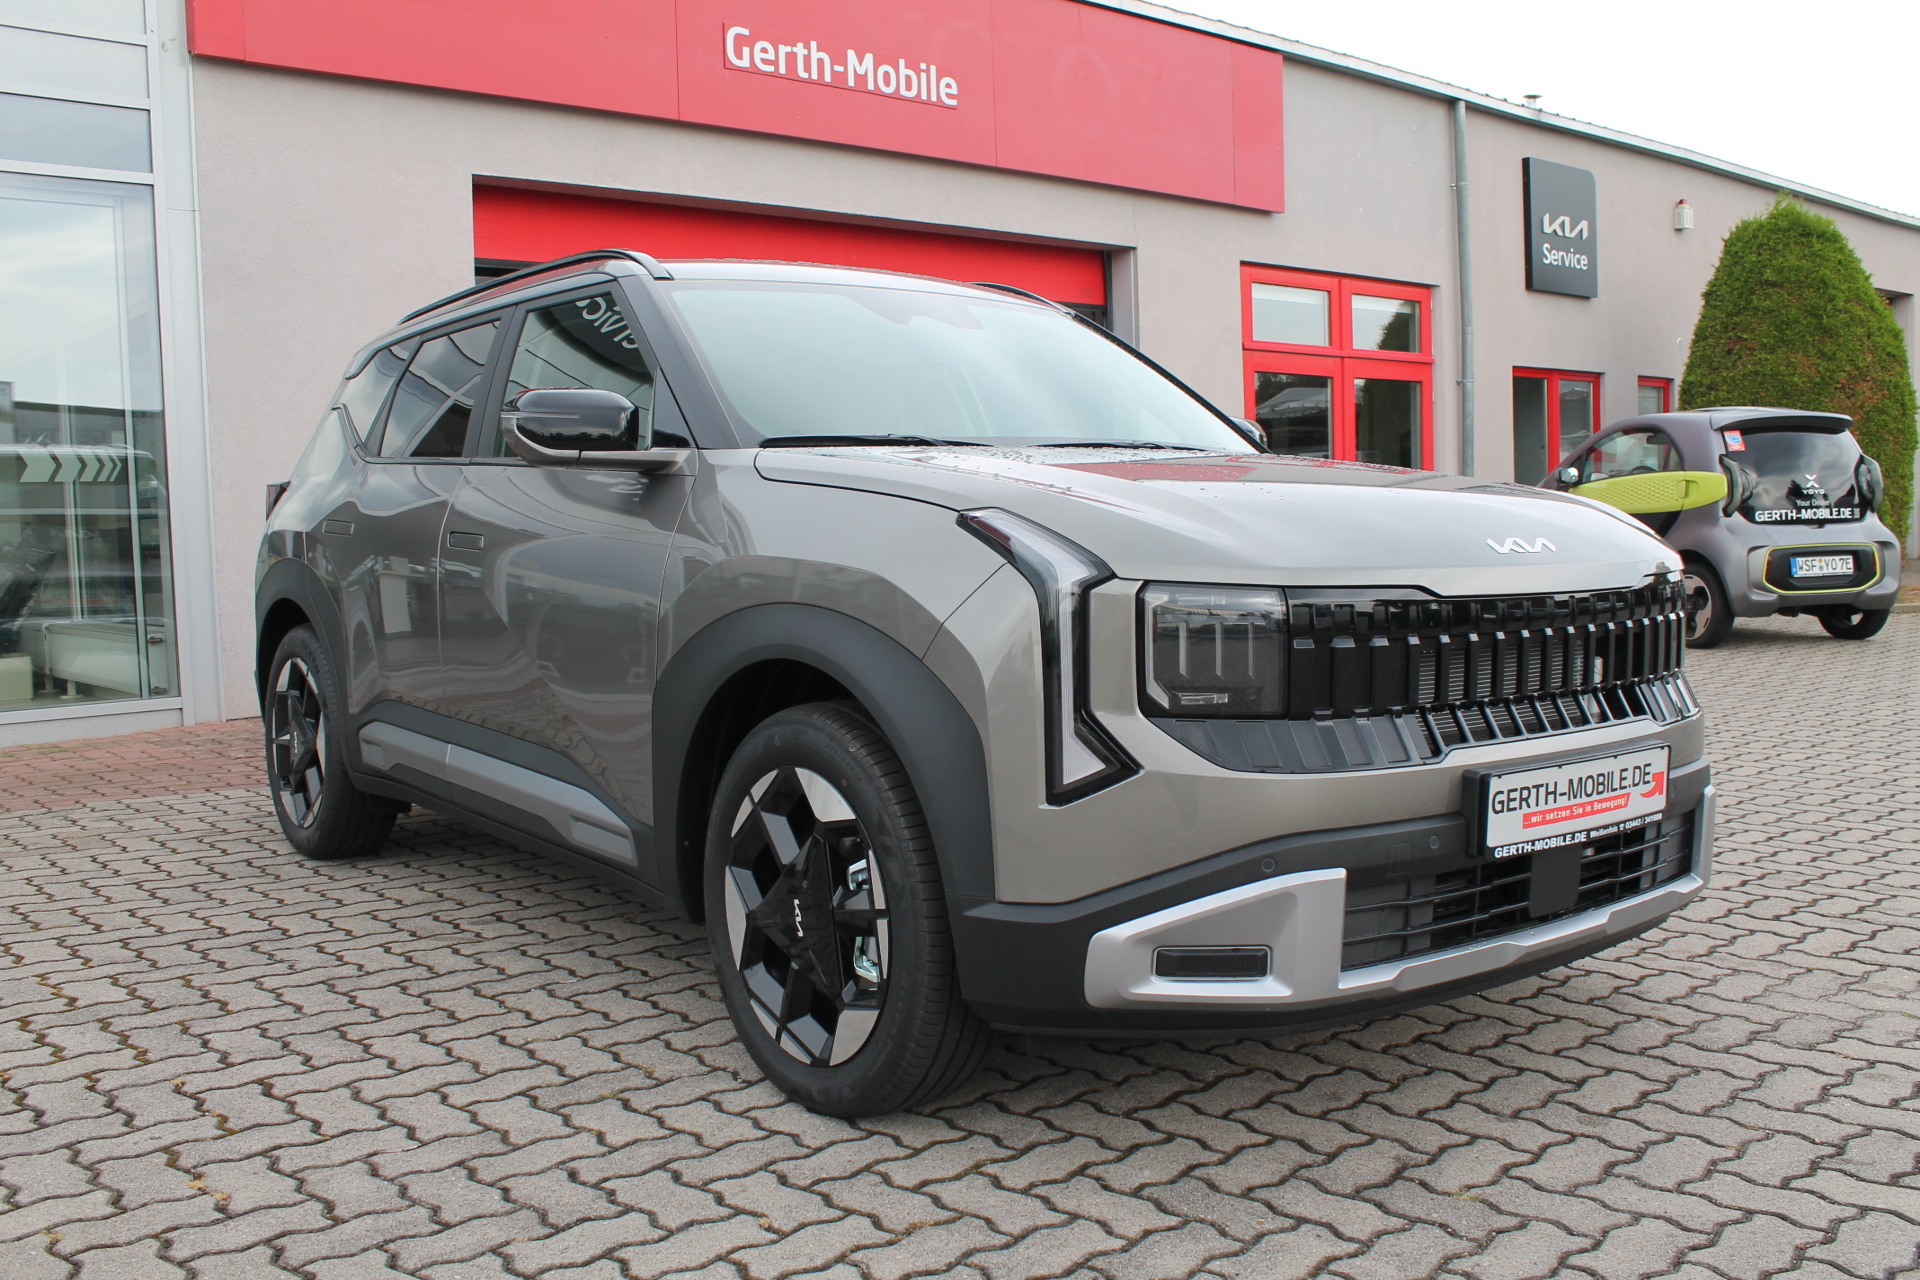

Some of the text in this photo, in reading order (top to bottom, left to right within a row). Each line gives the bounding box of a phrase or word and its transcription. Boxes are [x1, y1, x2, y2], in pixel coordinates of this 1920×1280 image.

[726, 26, 958, 106] Gerth-Mobile
[1542, 212, 1589, 240] KIA
[1542, 243, 1588, 270] Service
[1755, 508, 1852, 521] GERTH-MOBILE.DE
[1486, 537, 1557, 554] KIA
[1797, 558, 1817, 572] WSF
[1491, 763, 1652, 815] GERTH-MOBILE.DE
[1545, 809, 1571, 820] setzen
[1572, 805, 1583, 815] Sie
[1585, 803, 1592, 813] in
[1593, 795, 1628, 811] Bewegung!
[1494, 831, 1588, 859] GERTH-MOBILE.DE
[793, 899, 804, 937] KIA
